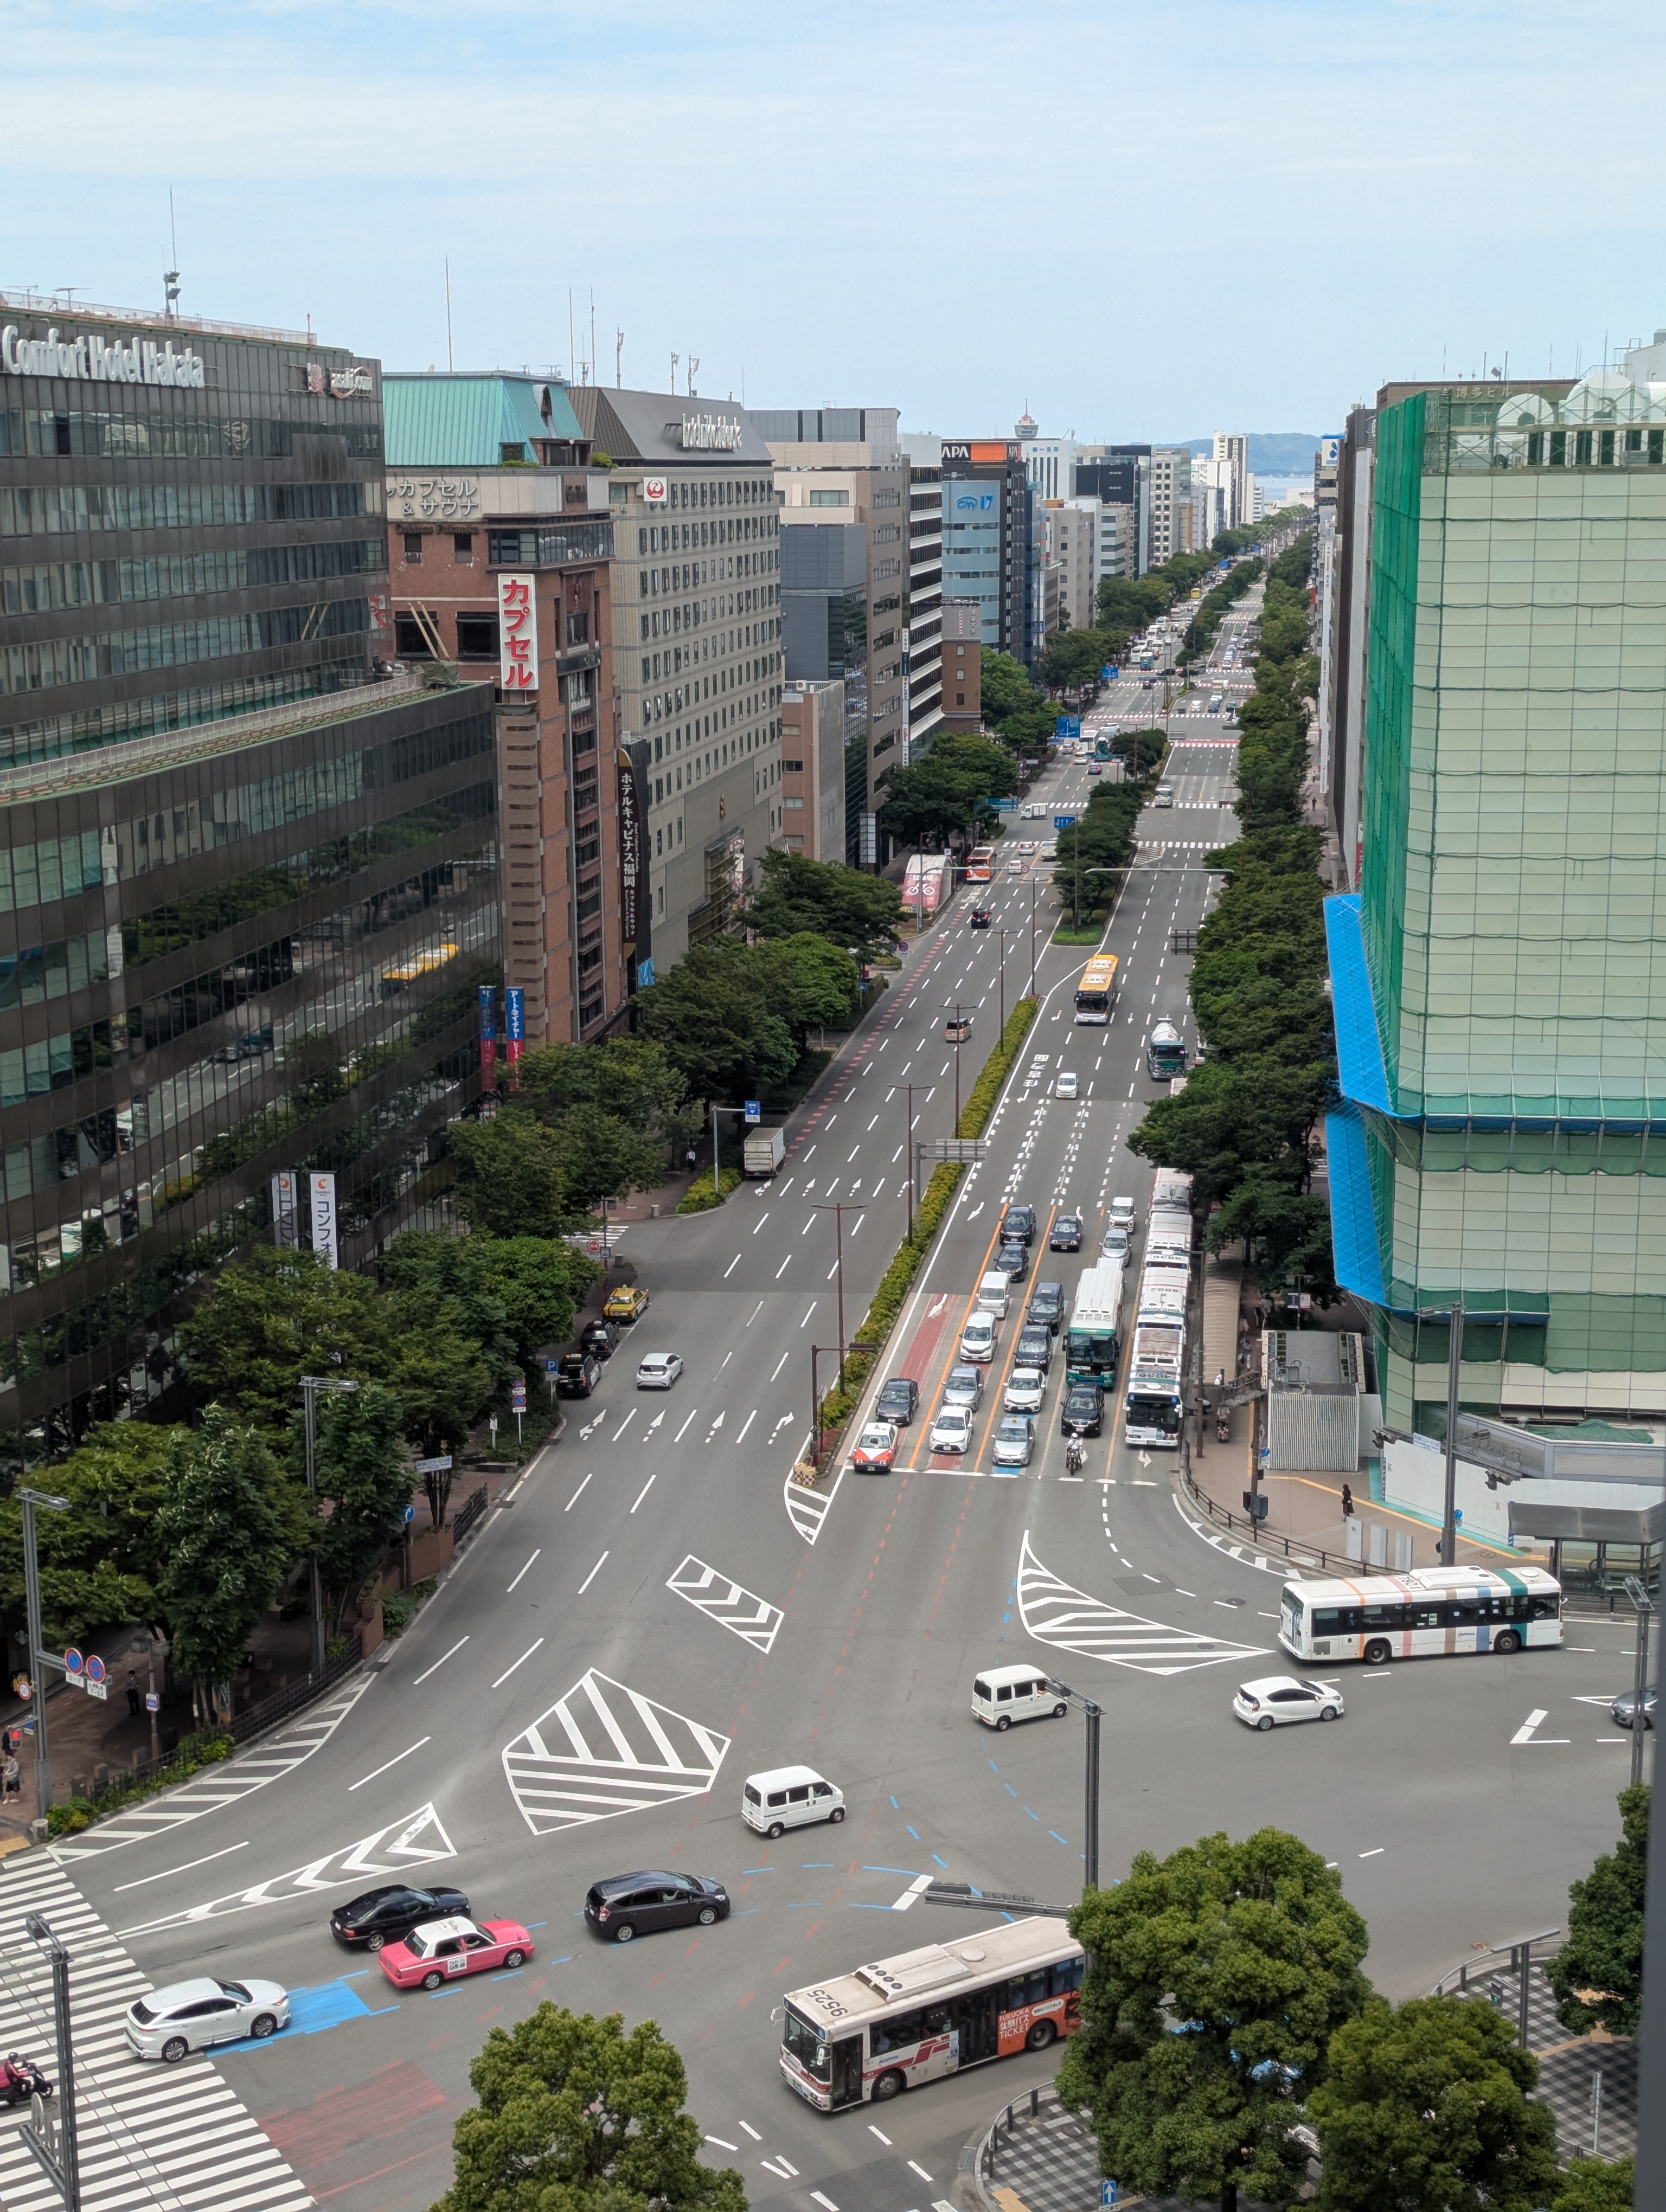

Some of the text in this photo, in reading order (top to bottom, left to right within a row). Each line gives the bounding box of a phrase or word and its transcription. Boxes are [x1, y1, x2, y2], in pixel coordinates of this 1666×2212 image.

[2, 325, 205, 388] Comfort Hotel Hakata
[941, 446, 970, 458] APA
[1008, 445, 1018, 458] APA
[402, 498, 479, 515] & サウナ
[436, 523, 479, 534] Fukuoka
[502, 578, 534, 688] カプセル
[621, 773, 636, 888] ホテルキャビナス福岡
[548, 1360, 555, 1371] P
[806, 1989, 849, 2017] 9525
[999, 2006, 1029, 2022] FUKUOKA
[999, 2022, 1030, 2040] TICKET
